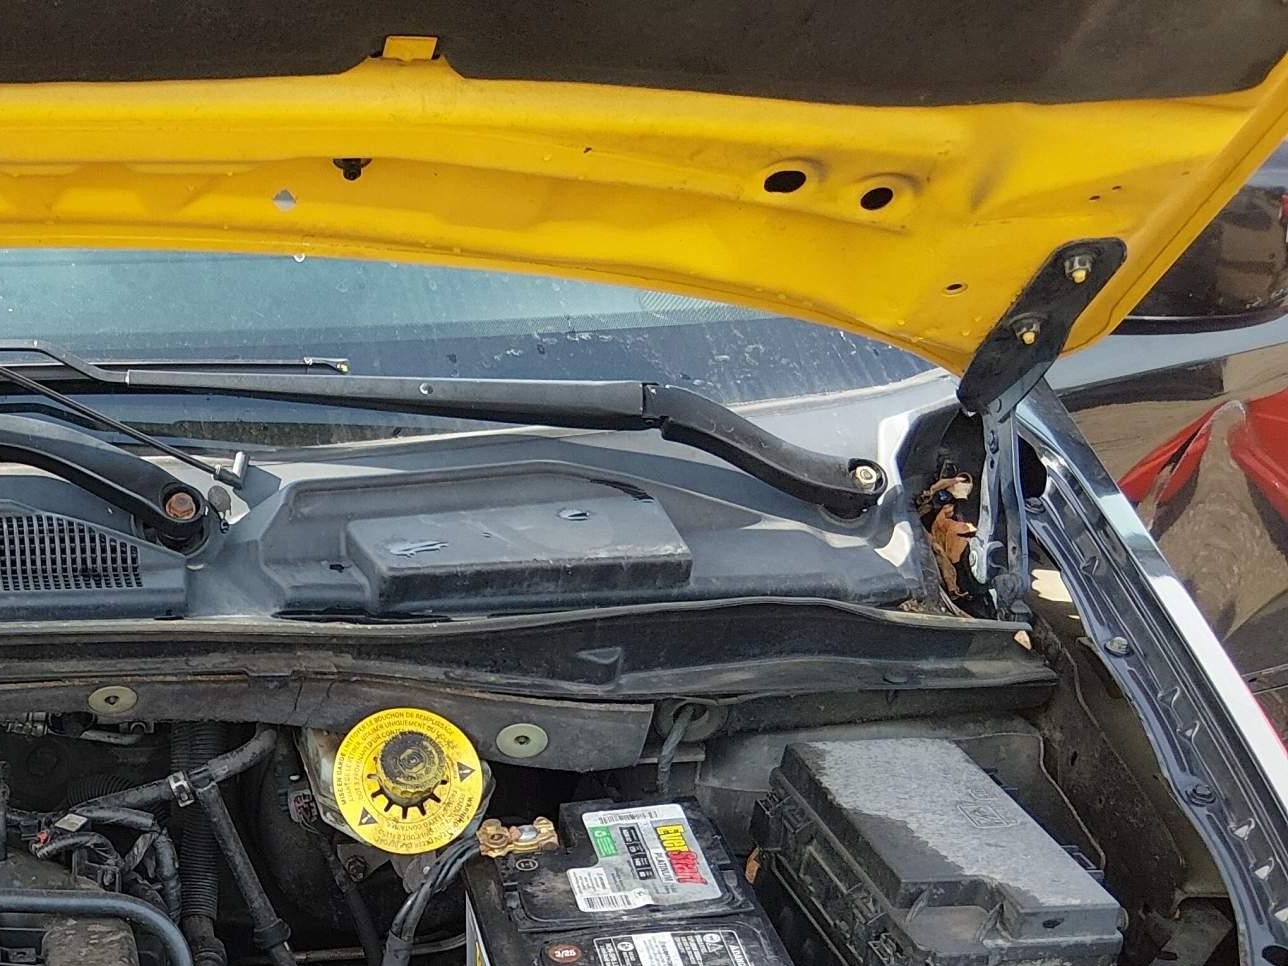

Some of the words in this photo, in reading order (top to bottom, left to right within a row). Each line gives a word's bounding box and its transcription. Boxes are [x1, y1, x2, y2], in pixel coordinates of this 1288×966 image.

[373, 710, 403, 725] BOUCHON
[653, 850, 674, 884] PLATINUM
[655, 824, 708, 886] EverStart
